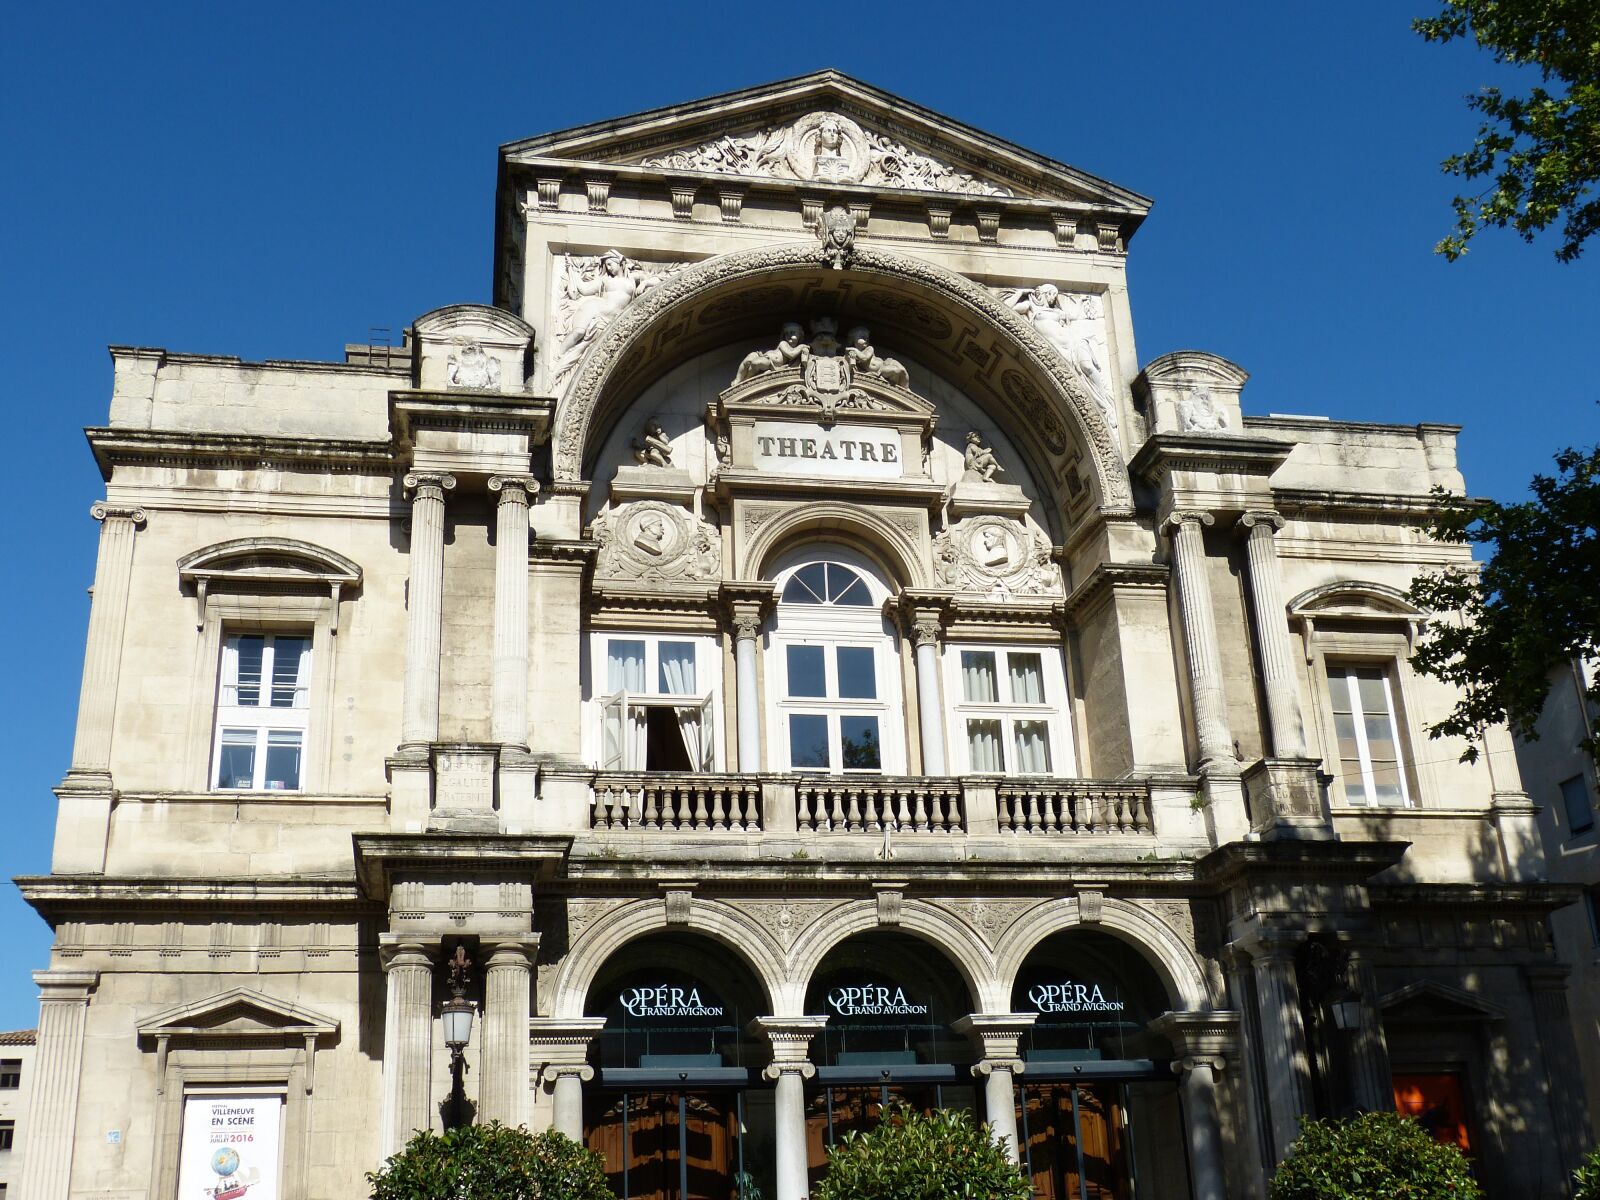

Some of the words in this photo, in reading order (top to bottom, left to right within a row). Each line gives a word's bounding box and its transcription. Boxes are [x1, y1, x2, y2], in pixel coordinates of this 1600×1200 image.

[757, 436, 897, 463] THEATRE
[620, 984, 704, 1008] OPÉRA
[828, 984, 909, 1007] OPÉRA
[1028, 980, 1106, 1004] OPÉRA
[629, 1001, 675, 1016] GRAND
[677, 1007, 723, 1015] AVIGNON
[837, 1000, 882, 1015] GRAND
[883, 1005, 928, 1014] AVIGNON
[1038, 997, 1080, 1012] GRAND
[1082, 1002, 1124, 1011] AVIGNON
[211, 1117, 224, 1126] EN
[230, 1134, 254, 1143] 2016
